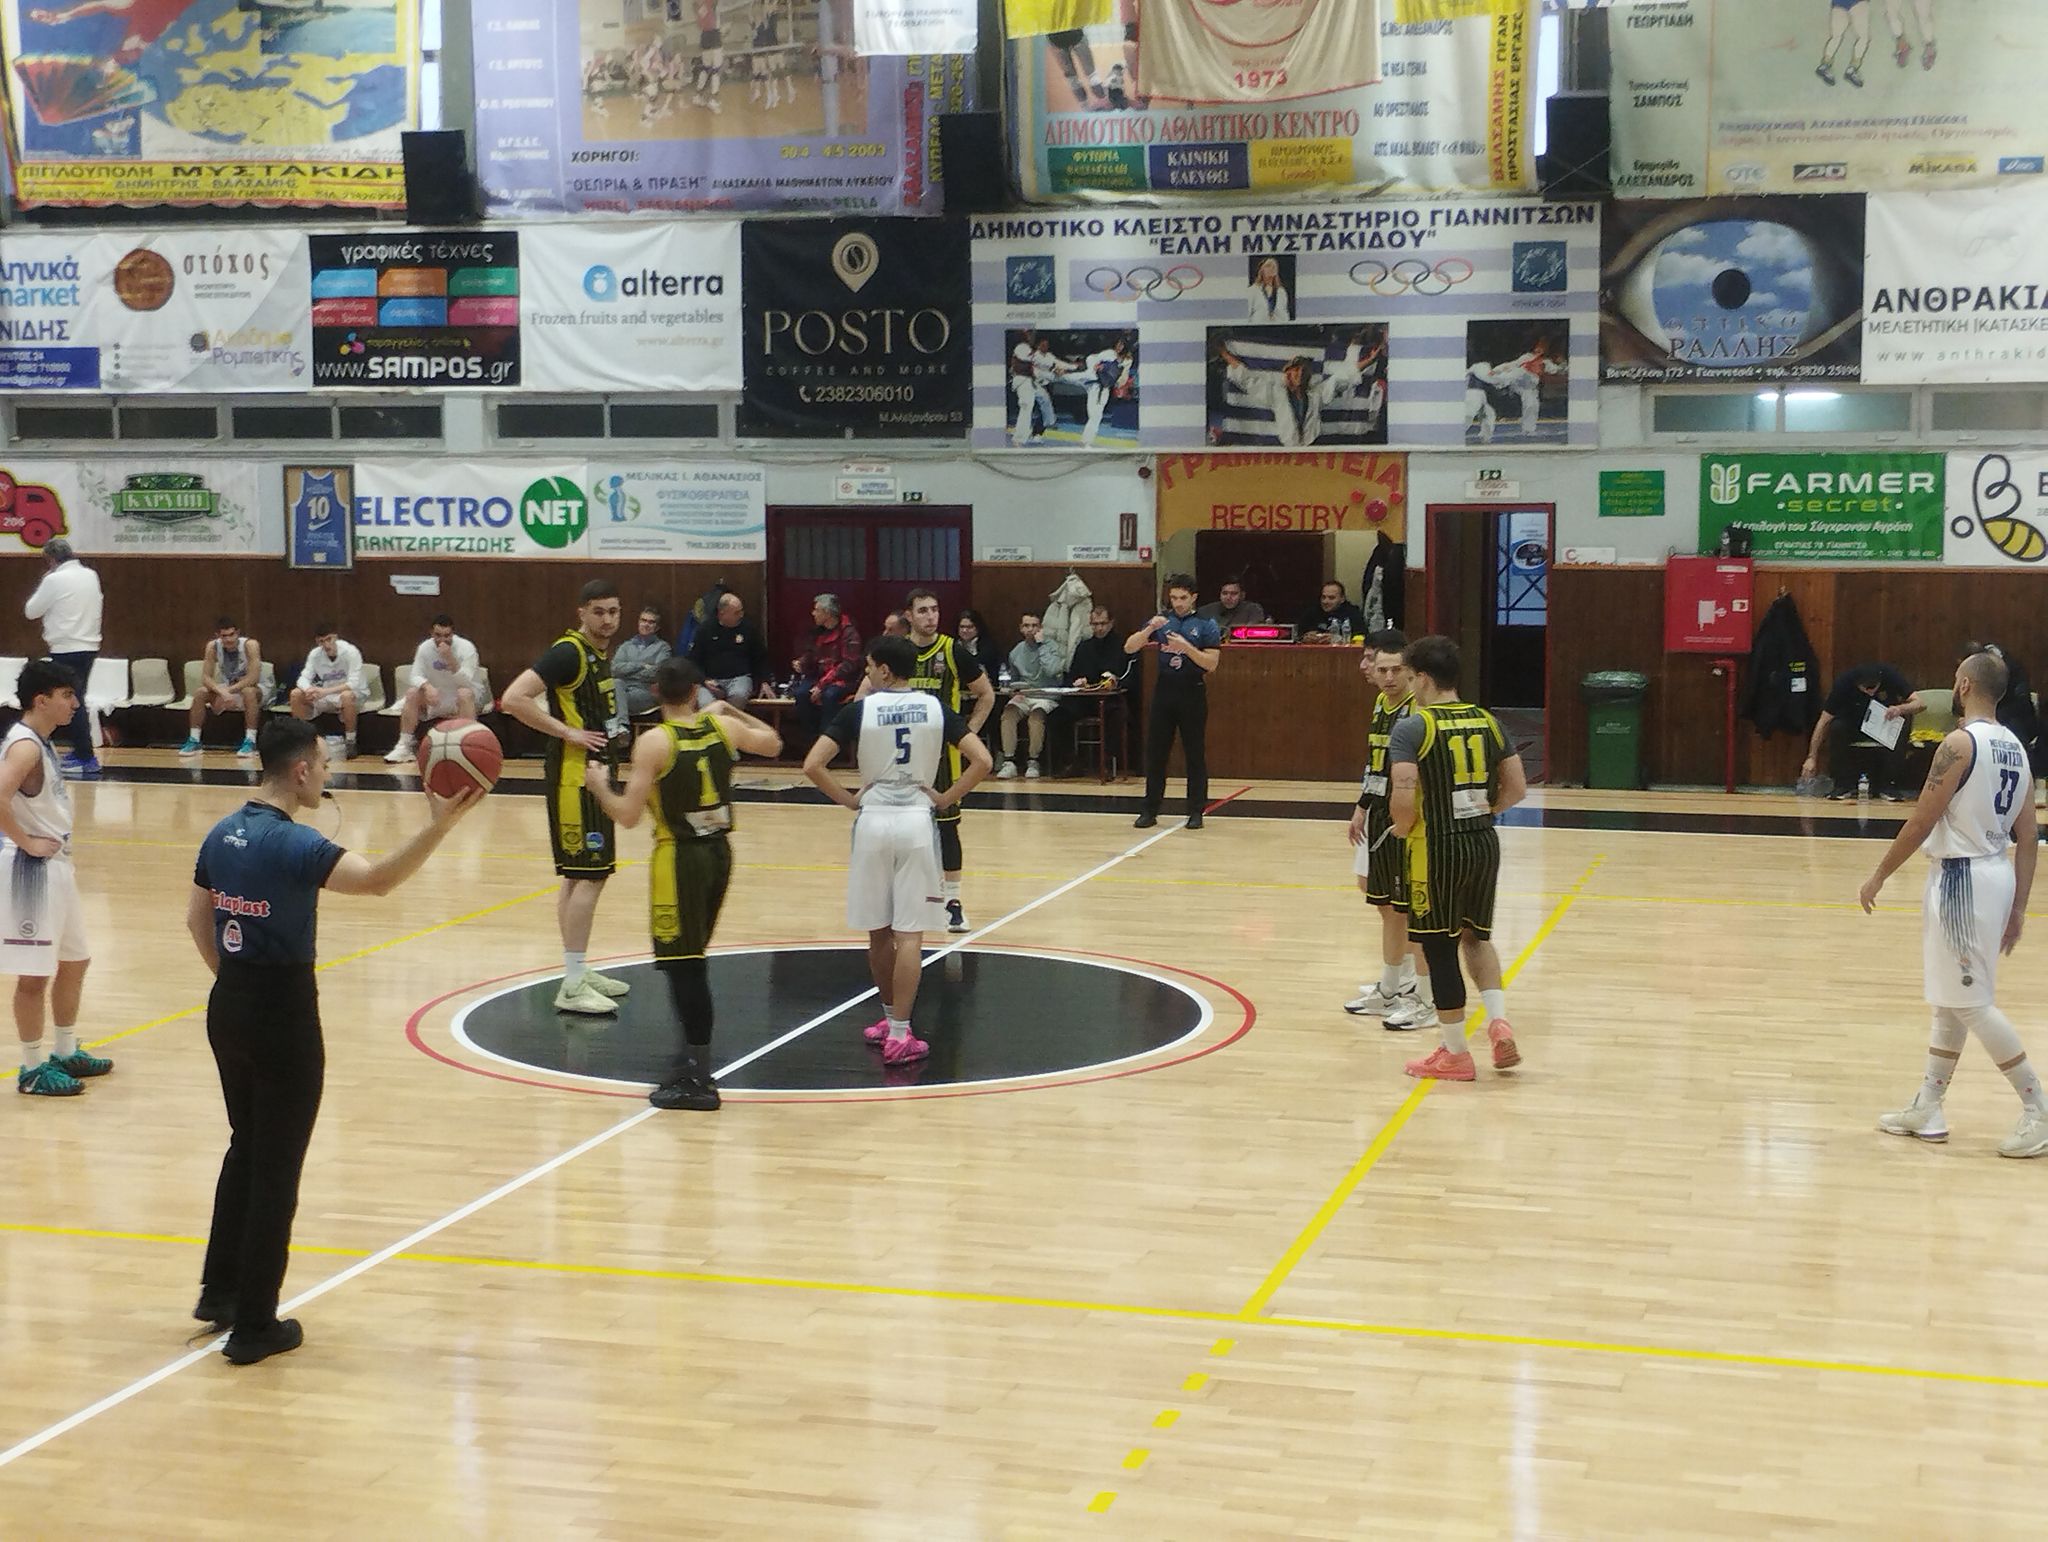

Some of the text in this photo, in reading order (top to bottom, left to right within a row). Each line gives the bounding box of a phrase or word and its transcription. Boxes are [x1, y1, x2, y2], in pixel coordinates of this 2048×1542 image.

[1045, 108, 1360, 145] ΔΗΜΟΤΙΚΟ ΑΘΛΗΤΙΚΟ ΚΕΝΤΡΟ
[633, 178, 642, 191] &
[970, 205, 1595, 240] ΔΗΜΟΤΙΚΟ ΚΛΕΙΣΤΟ ΓΥΜΝΑΣΤΗΡΙΟ ΓΙΑΝΝΙΤΣΩΝ
[341, 240, 494, 264] γραφικές τέχνες
[621, 268, 724, 296] alterra
[531, 308, 725, 328] Frozen fruits and vegetables
[763, 308, 950, 355] POSTO
[1868, 319, 1969, 335] ΜΕΛΕΤΗΤΙΚΗ
[1666, 335, 1799, 361] ΡΑΛΛΗΣ
[315, 356, 515, 384] www.SAMPOS.gr
[766, 365, 948, 377] COFFEE AND MORE
[815, 385, 915, 403] 2382306010
[1158, 452, 1404, 492] ΓΡΑΜΜΑΤΕΙΑ
[1746, 472, 1935, 494] FARMER
[307, 495, 330, 520] 10
[355, 496, 583, 528] ELECTRO NET
[1211, 503, 1349, 529] REGISTRY
[895, 727, 911, 766] 5
[1448, 734, 1489, 786] 11
[696, 756, 721, 806] 1
